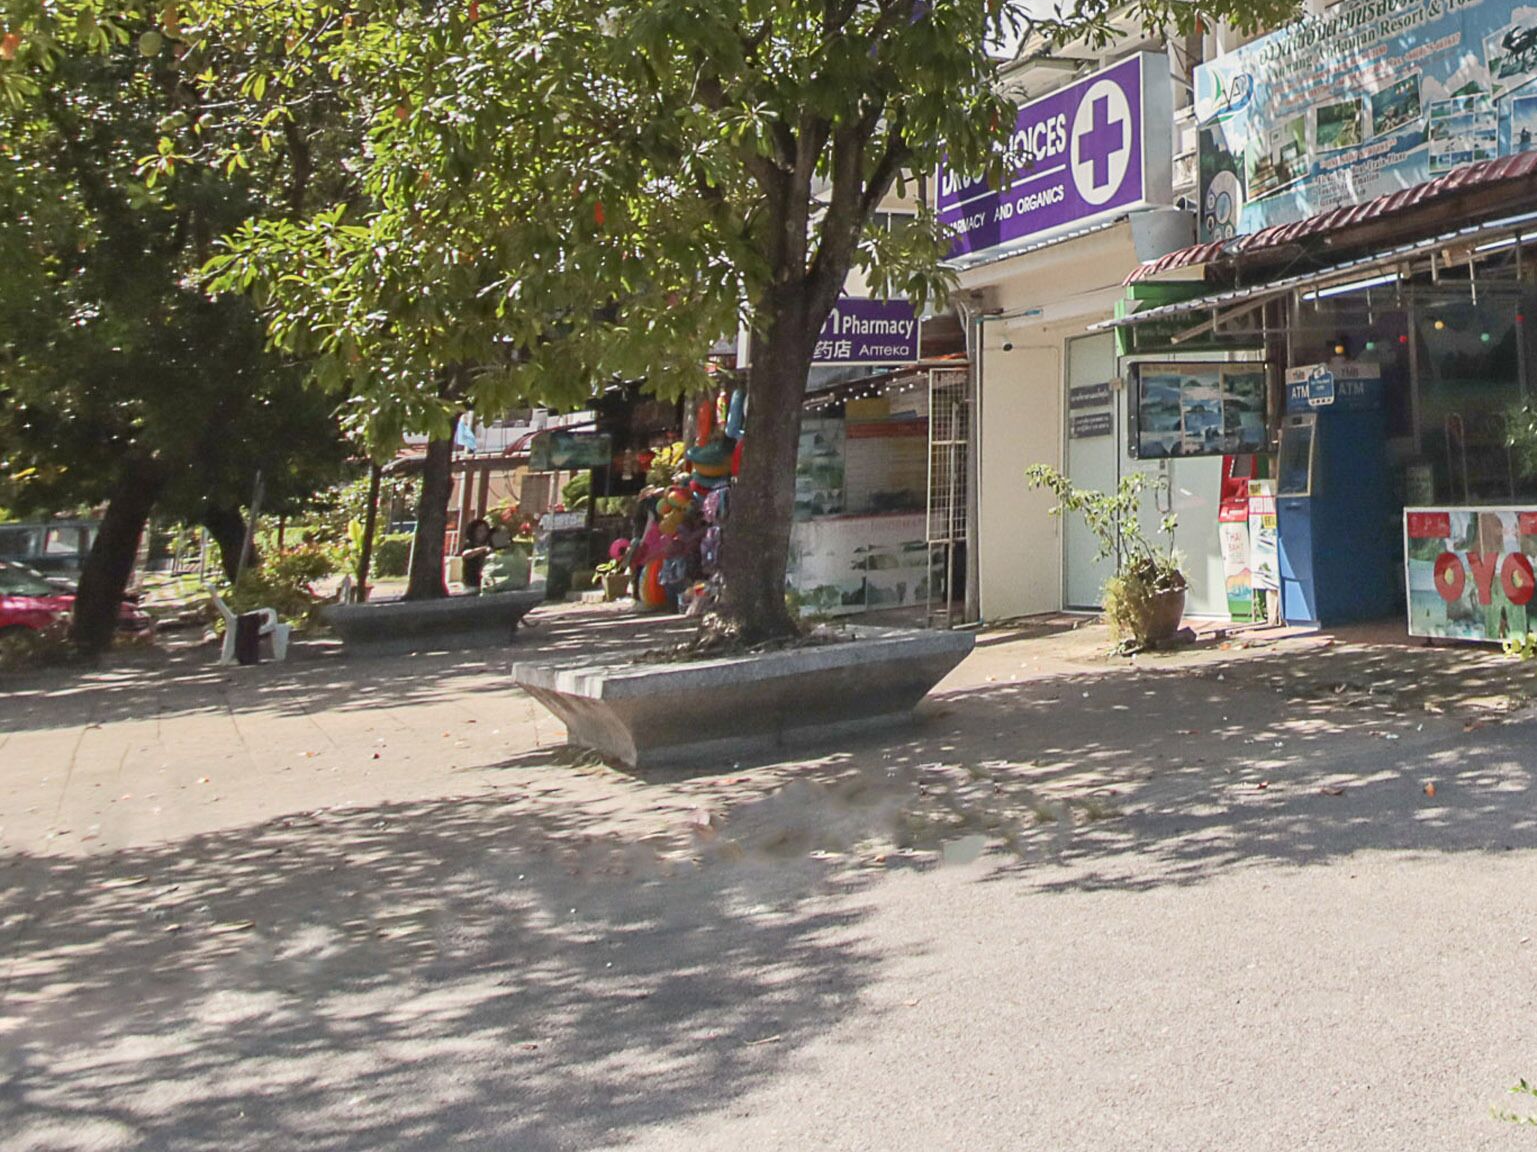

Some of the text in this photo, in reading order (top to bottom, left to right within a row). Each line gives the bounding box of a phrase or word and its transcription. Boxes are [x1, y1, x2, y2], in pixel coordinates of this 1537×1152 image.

[1380, 8, 1424, 36] Resort
[1428, 0, 1442, 17] &
[993, 113, 1067, 173] HOICES
[994, 203, 1013, 223] AND
[1017, 185, 1064, 214] ORGANICS
[842, 315, 914, 339] Pharmacy
[813, 339, 852, 359] 药店
[858, 344, 909, 356] Аптека
[1291, 385, 1309, 400] ATM
[1338, 381, 1364, 395] ATM
[1434, 552, 1535, 605] OYO
